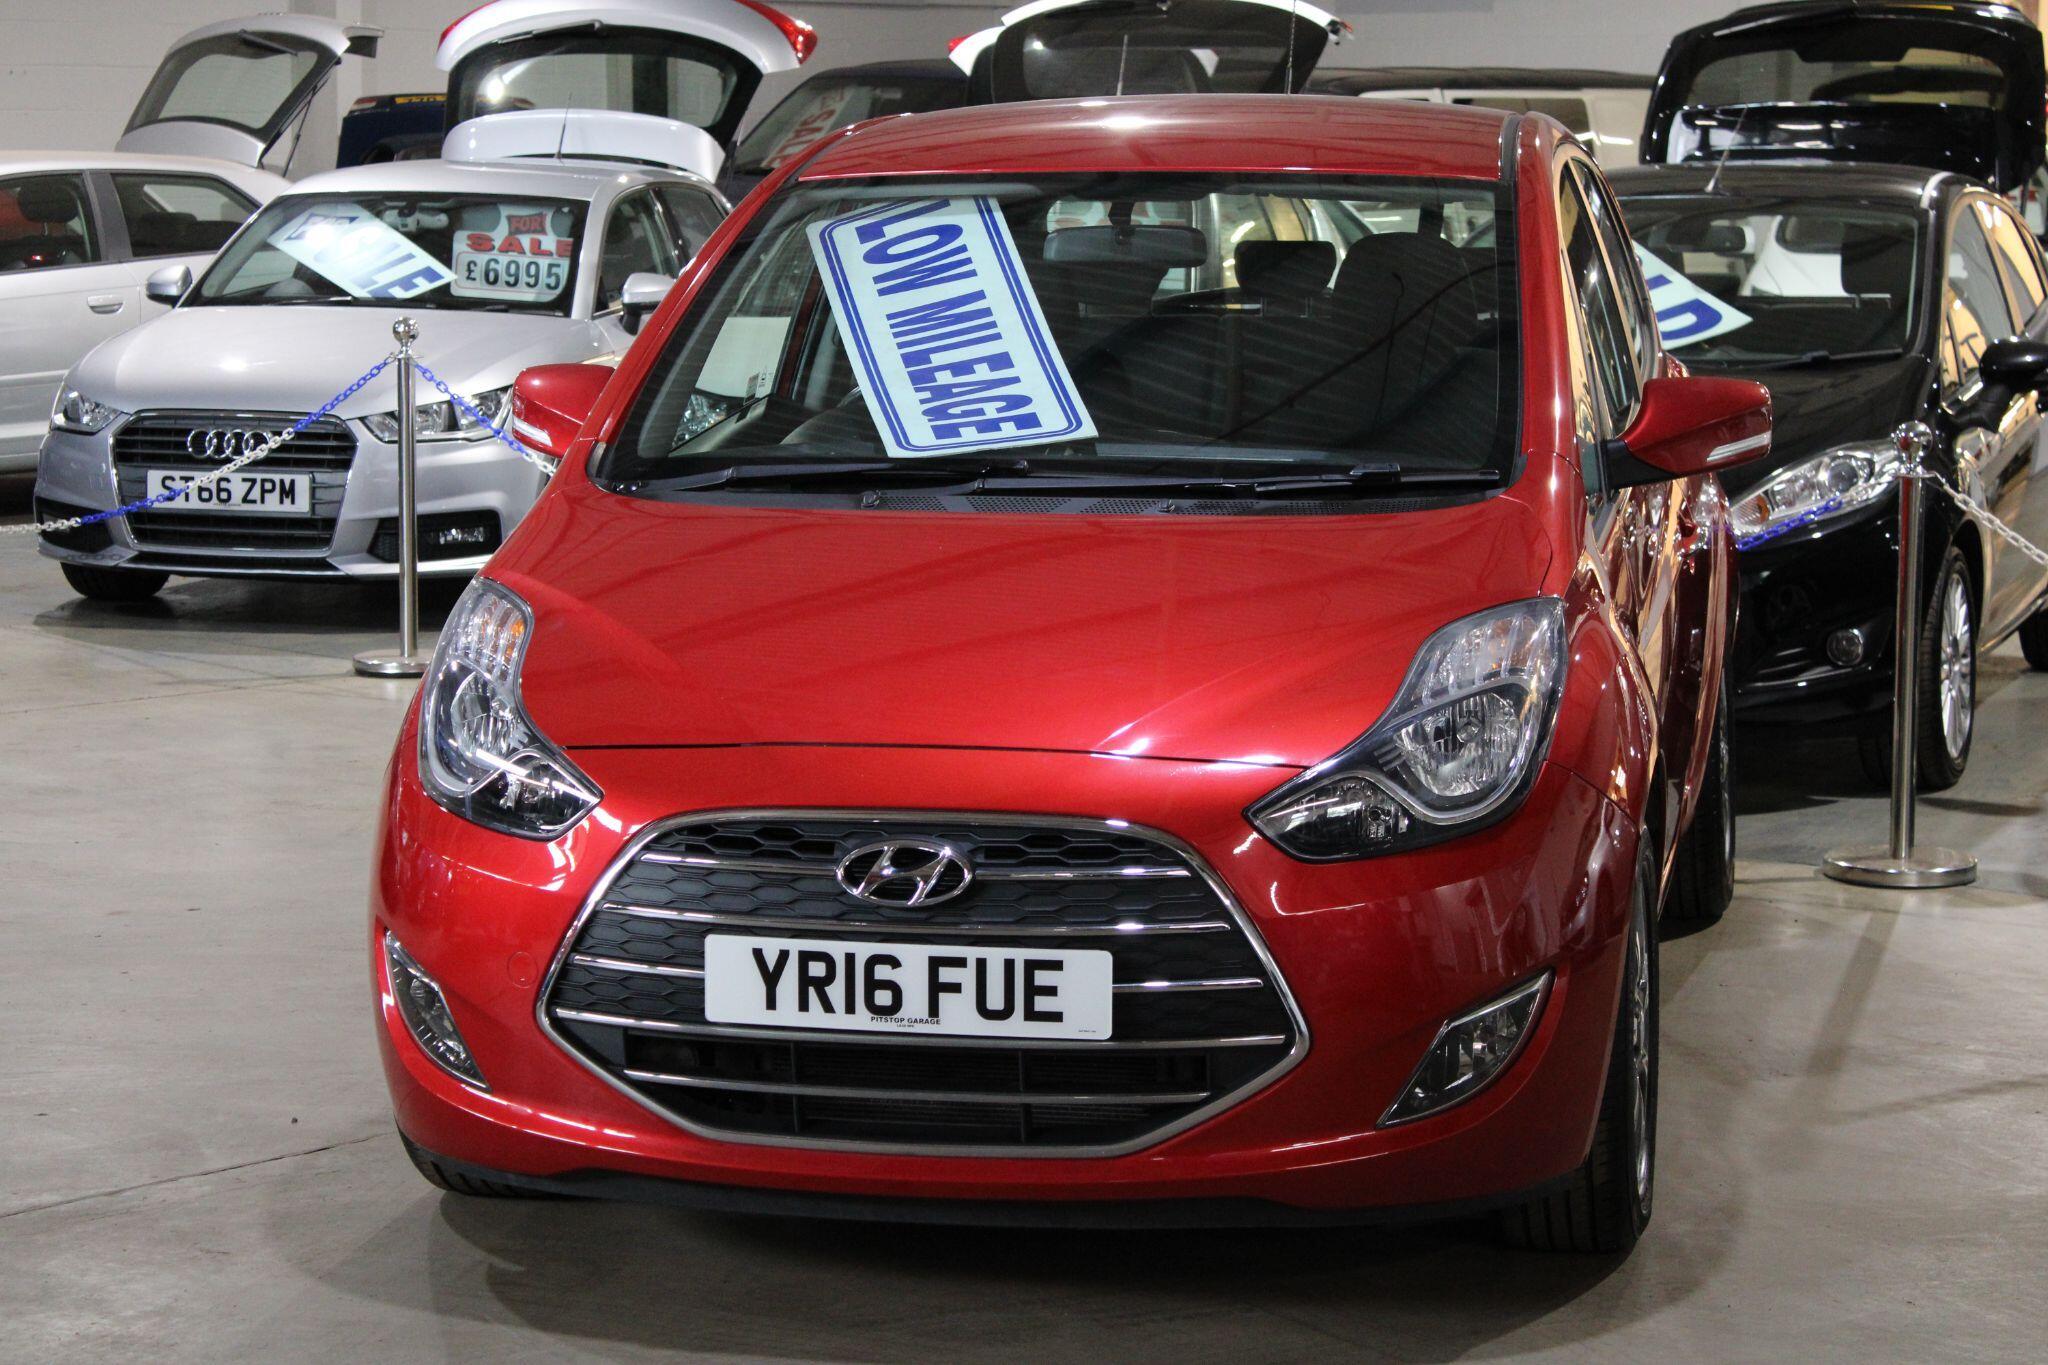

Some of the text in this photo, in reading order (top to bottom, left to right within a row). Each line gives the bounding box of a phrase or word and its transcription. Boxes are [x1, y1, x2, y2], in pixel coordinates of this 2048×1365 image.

[511, 213, 547, 232] FOR
[466, 231, 574, 258] SALE
[313, 226, 445, 299] LE
[465, 258, 562, 290] £6995
[855, 200, 1042, 440] LOW MILEAGE
[161, 475, 296, 505] ST66 ZPM
[752, 948, 1064, 1023] YR16 FUE
[870, 1016, 941, 1025] PITSTOP GARAGE
